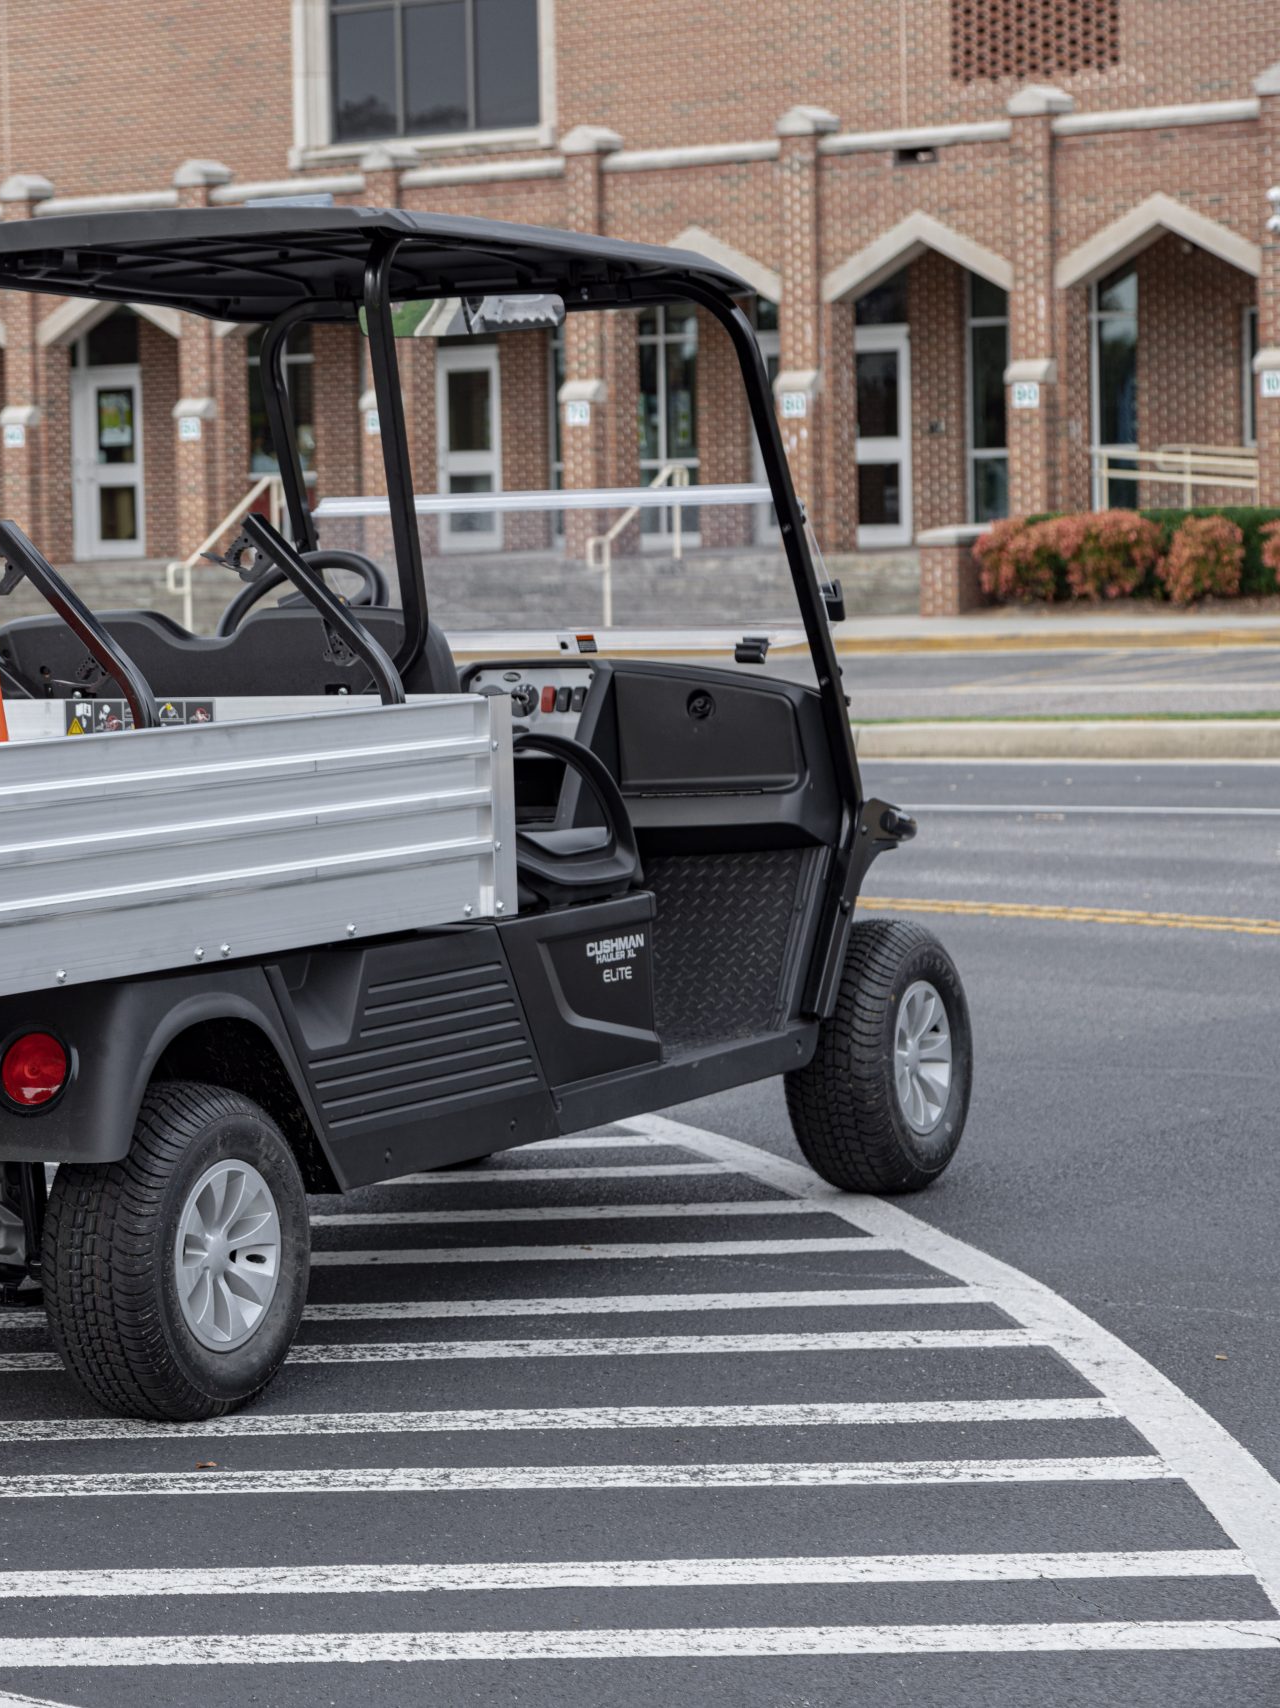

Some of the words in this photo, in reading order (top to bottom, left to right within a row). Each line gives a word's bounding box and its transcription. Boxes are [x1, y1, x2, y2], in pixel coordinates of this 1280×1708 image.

[1266, 377, 1280, 391] 10
[586, 933, 644, 957] CUSHMAN
[596, 951, 625, 964] HAULER
[627, 948, 637, 959] XL
